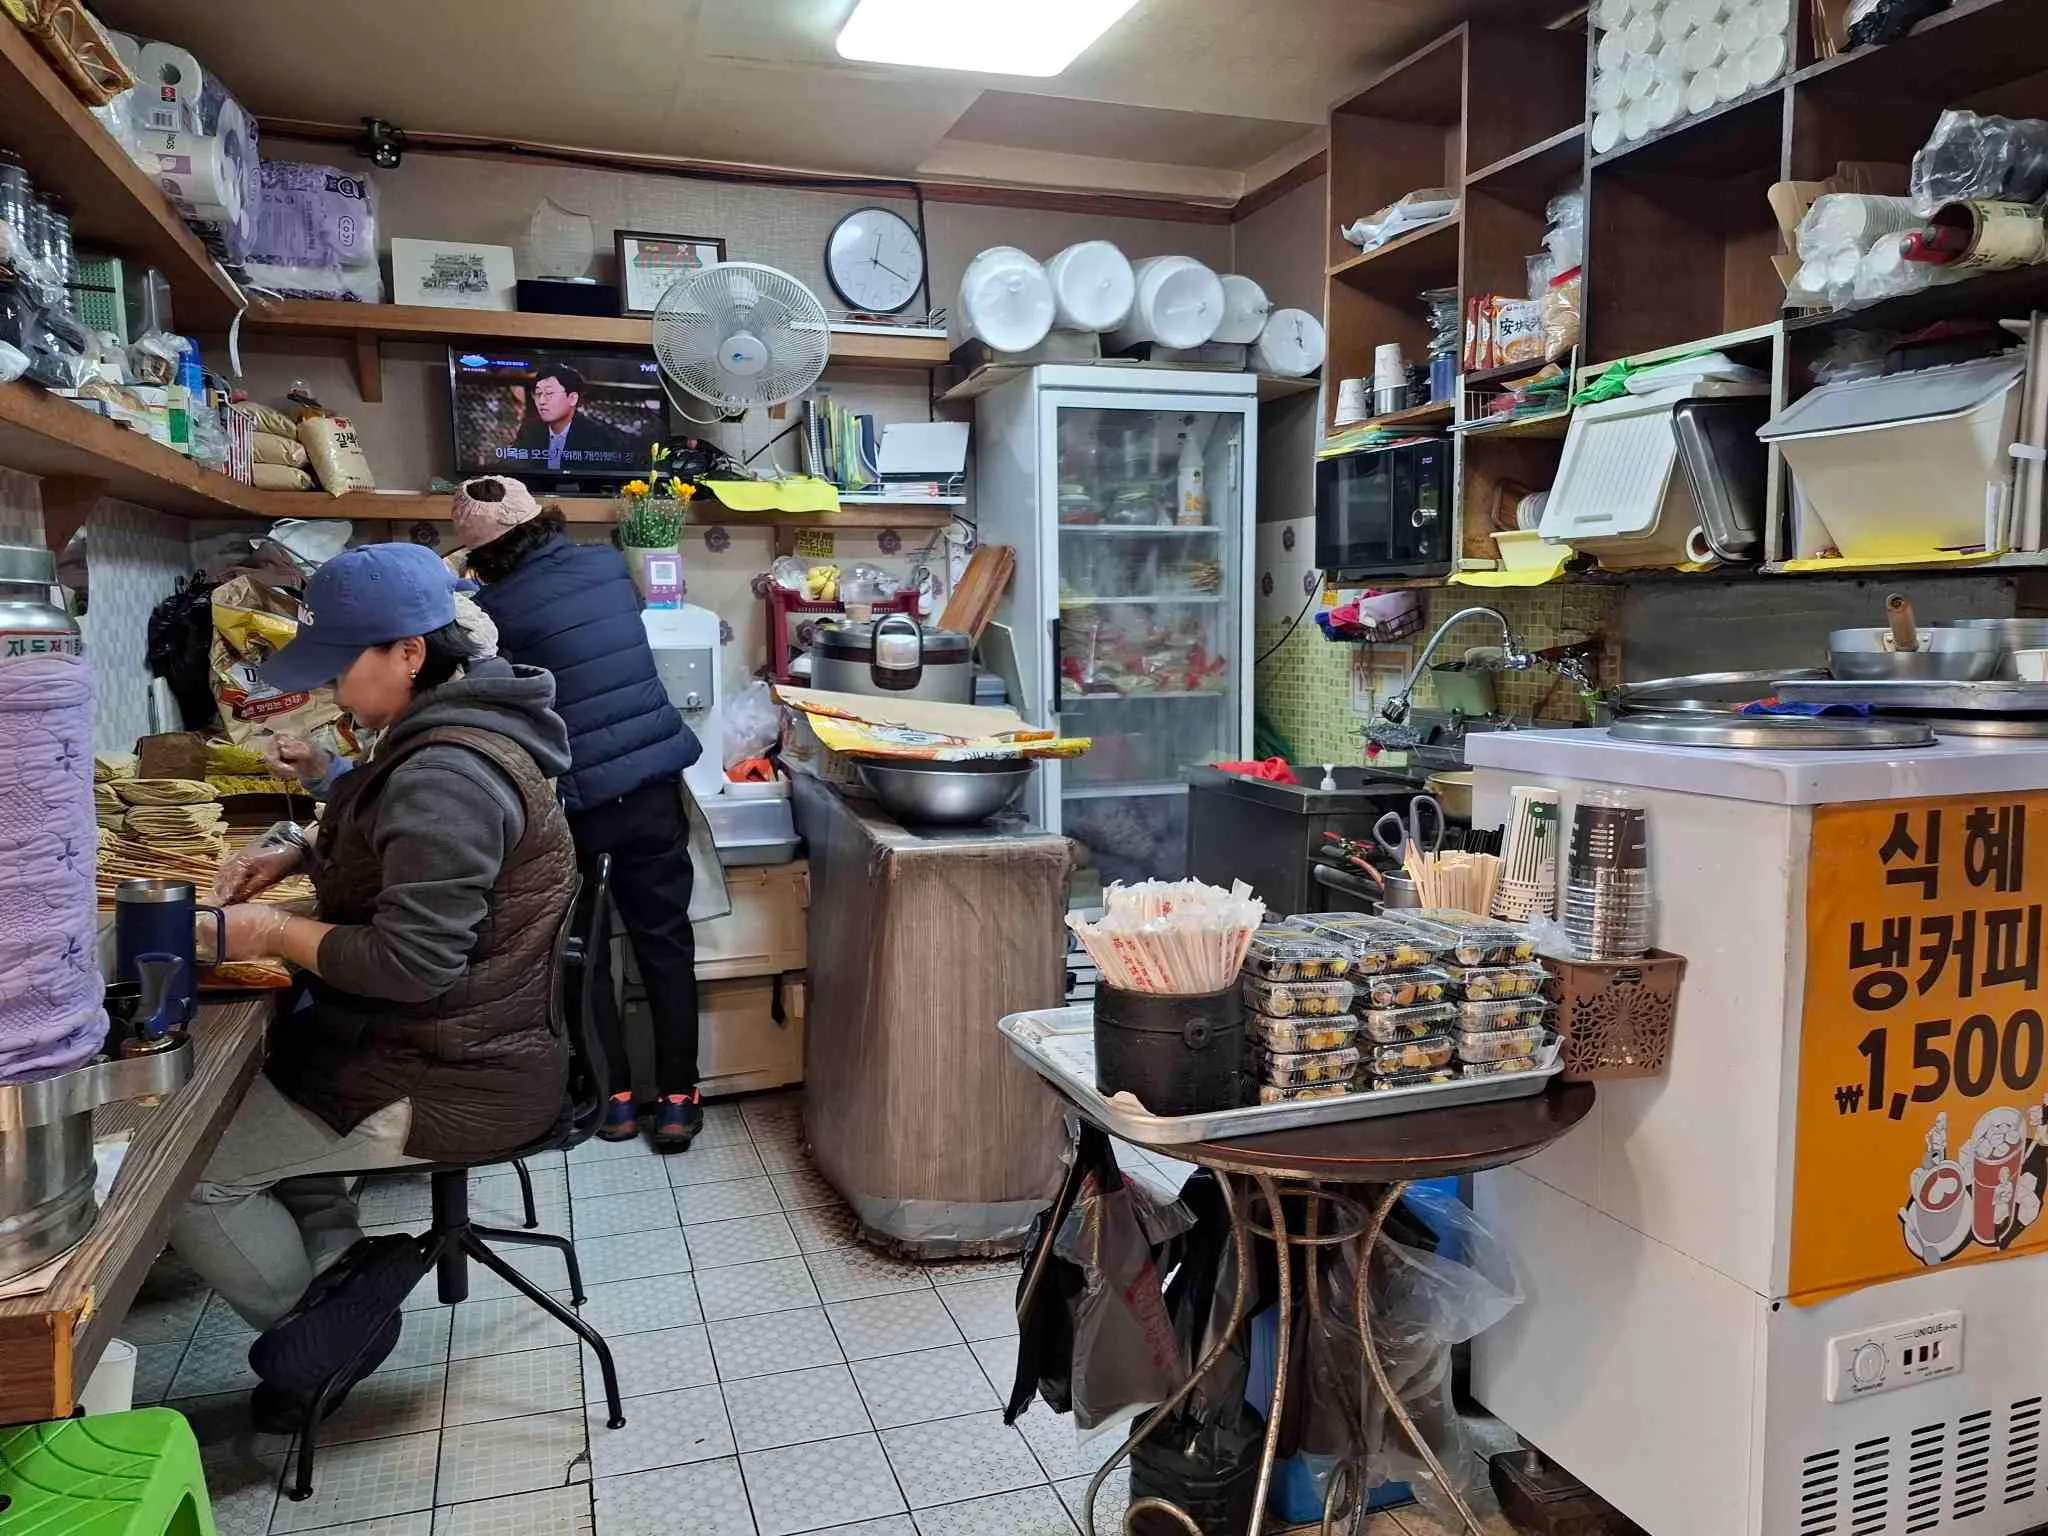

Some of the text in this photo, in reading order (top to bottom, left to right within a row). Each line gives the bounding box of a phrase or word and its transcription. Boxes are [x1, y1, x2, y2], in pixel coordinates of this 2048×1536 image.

[495, 448, 529, 460] 이목을
[1878, 804, 2027, 900] 식혜
[1849, 904, 2042, 1011] 냉커피
[1834, 1008, 2044, 1121] ₩1,500
